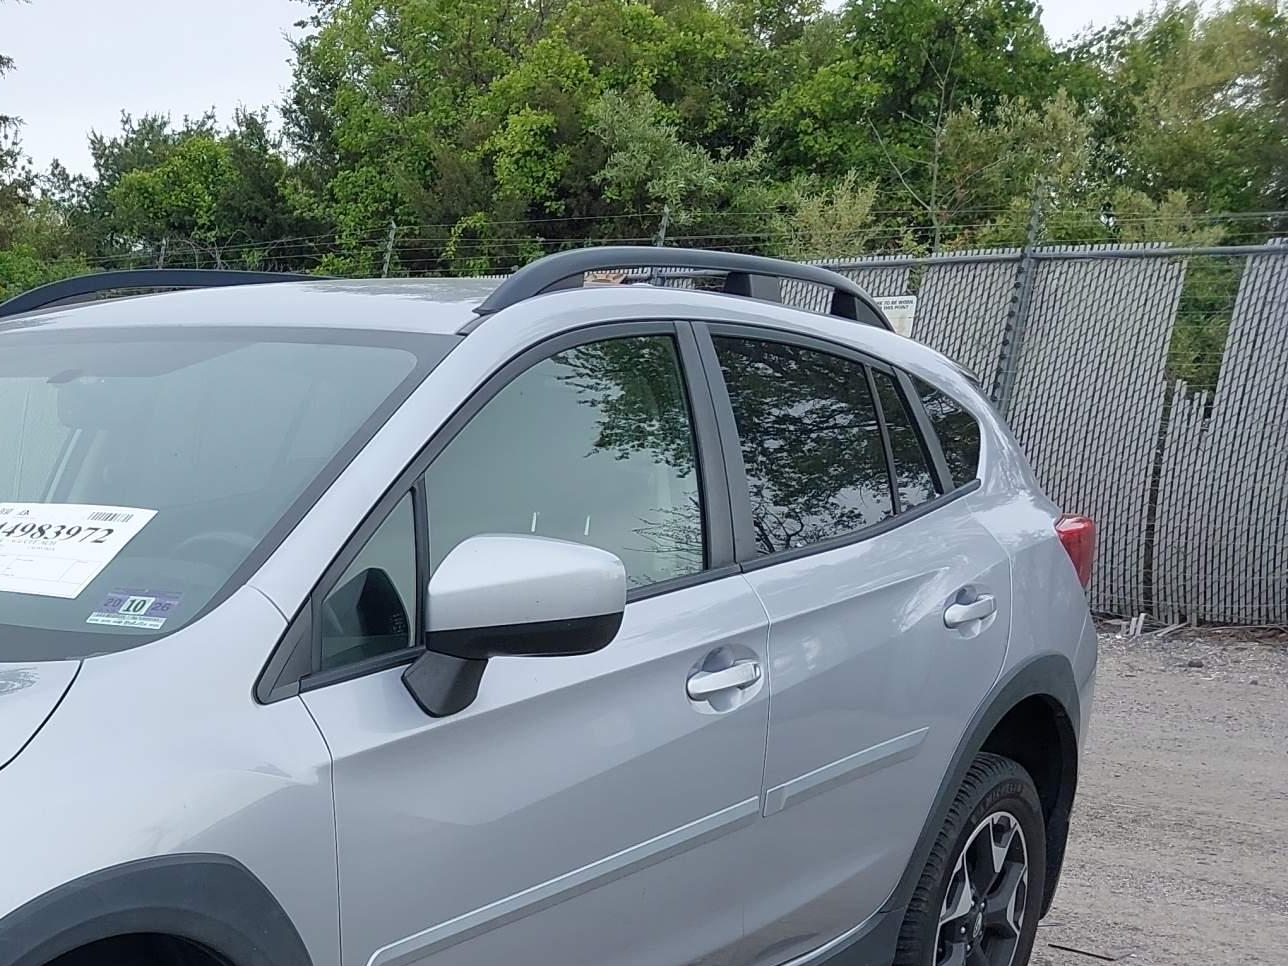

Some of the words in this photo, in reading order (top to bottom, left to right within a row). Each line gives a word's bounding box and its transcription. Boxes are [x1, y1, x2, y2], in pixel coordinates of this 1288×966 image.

[104, 598, 122, 607] 20
[122, 599, 147, 613] 10
[151, 602, 172, 611] 26
